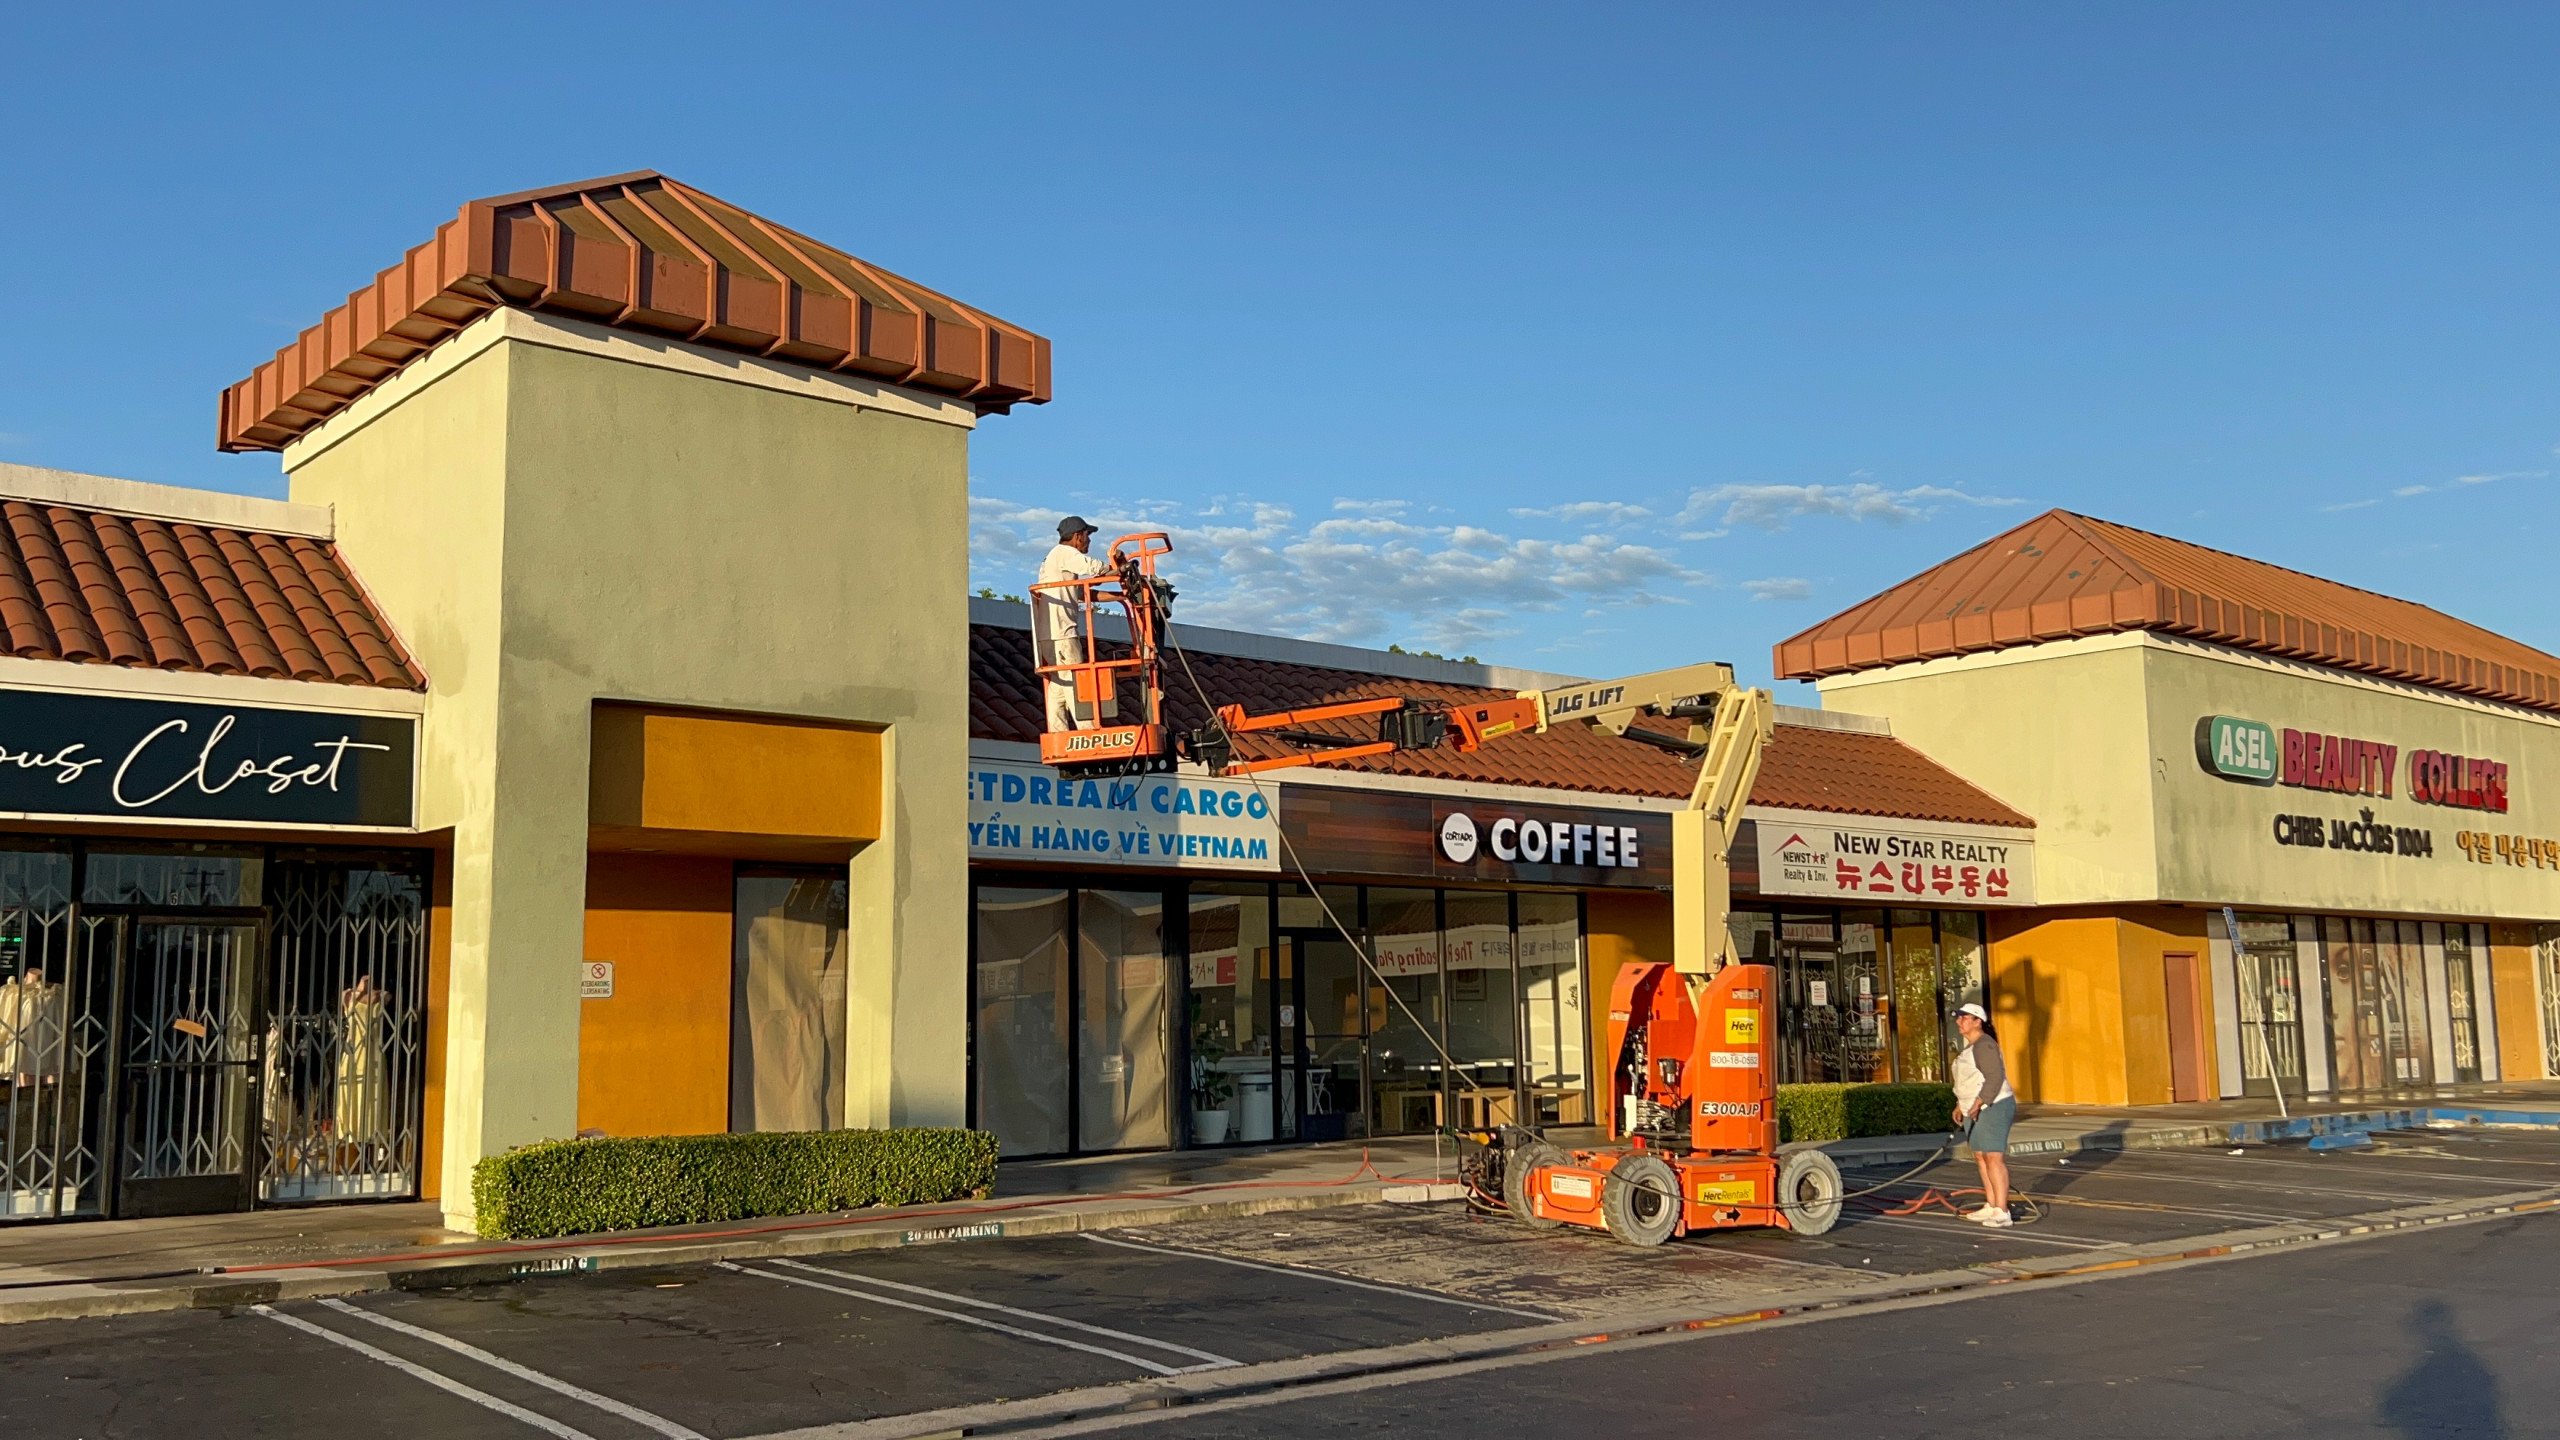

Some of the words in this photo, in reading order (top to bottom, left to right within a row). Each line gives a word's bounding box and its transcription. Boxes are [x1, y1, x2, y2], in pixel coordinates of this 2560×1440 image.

[1553, 693, 1584, 715] JLG
[1588, 685, 1625, 708] LIFT
[1066, 732, 1136, 752] JibPLUS
[2218, 724, 2270, 771] ASEL
[113, 714, 391, 808] Closet
[2277, 727, 2398, 800] BEAUTY
[2405, 749, 2509, 814] COLLEGE
[1150, 785, 1269, 820] CARGO
[1032, 819, 1110, 853] HÀNG
[1158, 833, 1269, 861] VIETNAM
[1445, 831, 1474, 843] CORTADO
[1490, 817, 1639, 868] COFFEE
[1833, 831, 1881, 856] NEW
[1886, 836, 1936, 860] STAR
[1941, 839, 2009, 864] REALTY
[2273, 813, 2325, 848] CHRIS
[2328, 819, 2394, 855] JACOBS
[2394, 826, 2433, 859] 1004
[1784, 868, 1806, 883] Realty
[1807, 869, 1813, 881] &
[1814, 870, 1829, 882] Inv.
[1731, 1021, 1754, 1031] Herc
[1701, 1103, 1759, 1116] E300AJP
[907, 1230, 921, 1242] 20
[947, 1224, 999, 1238] PARKING
